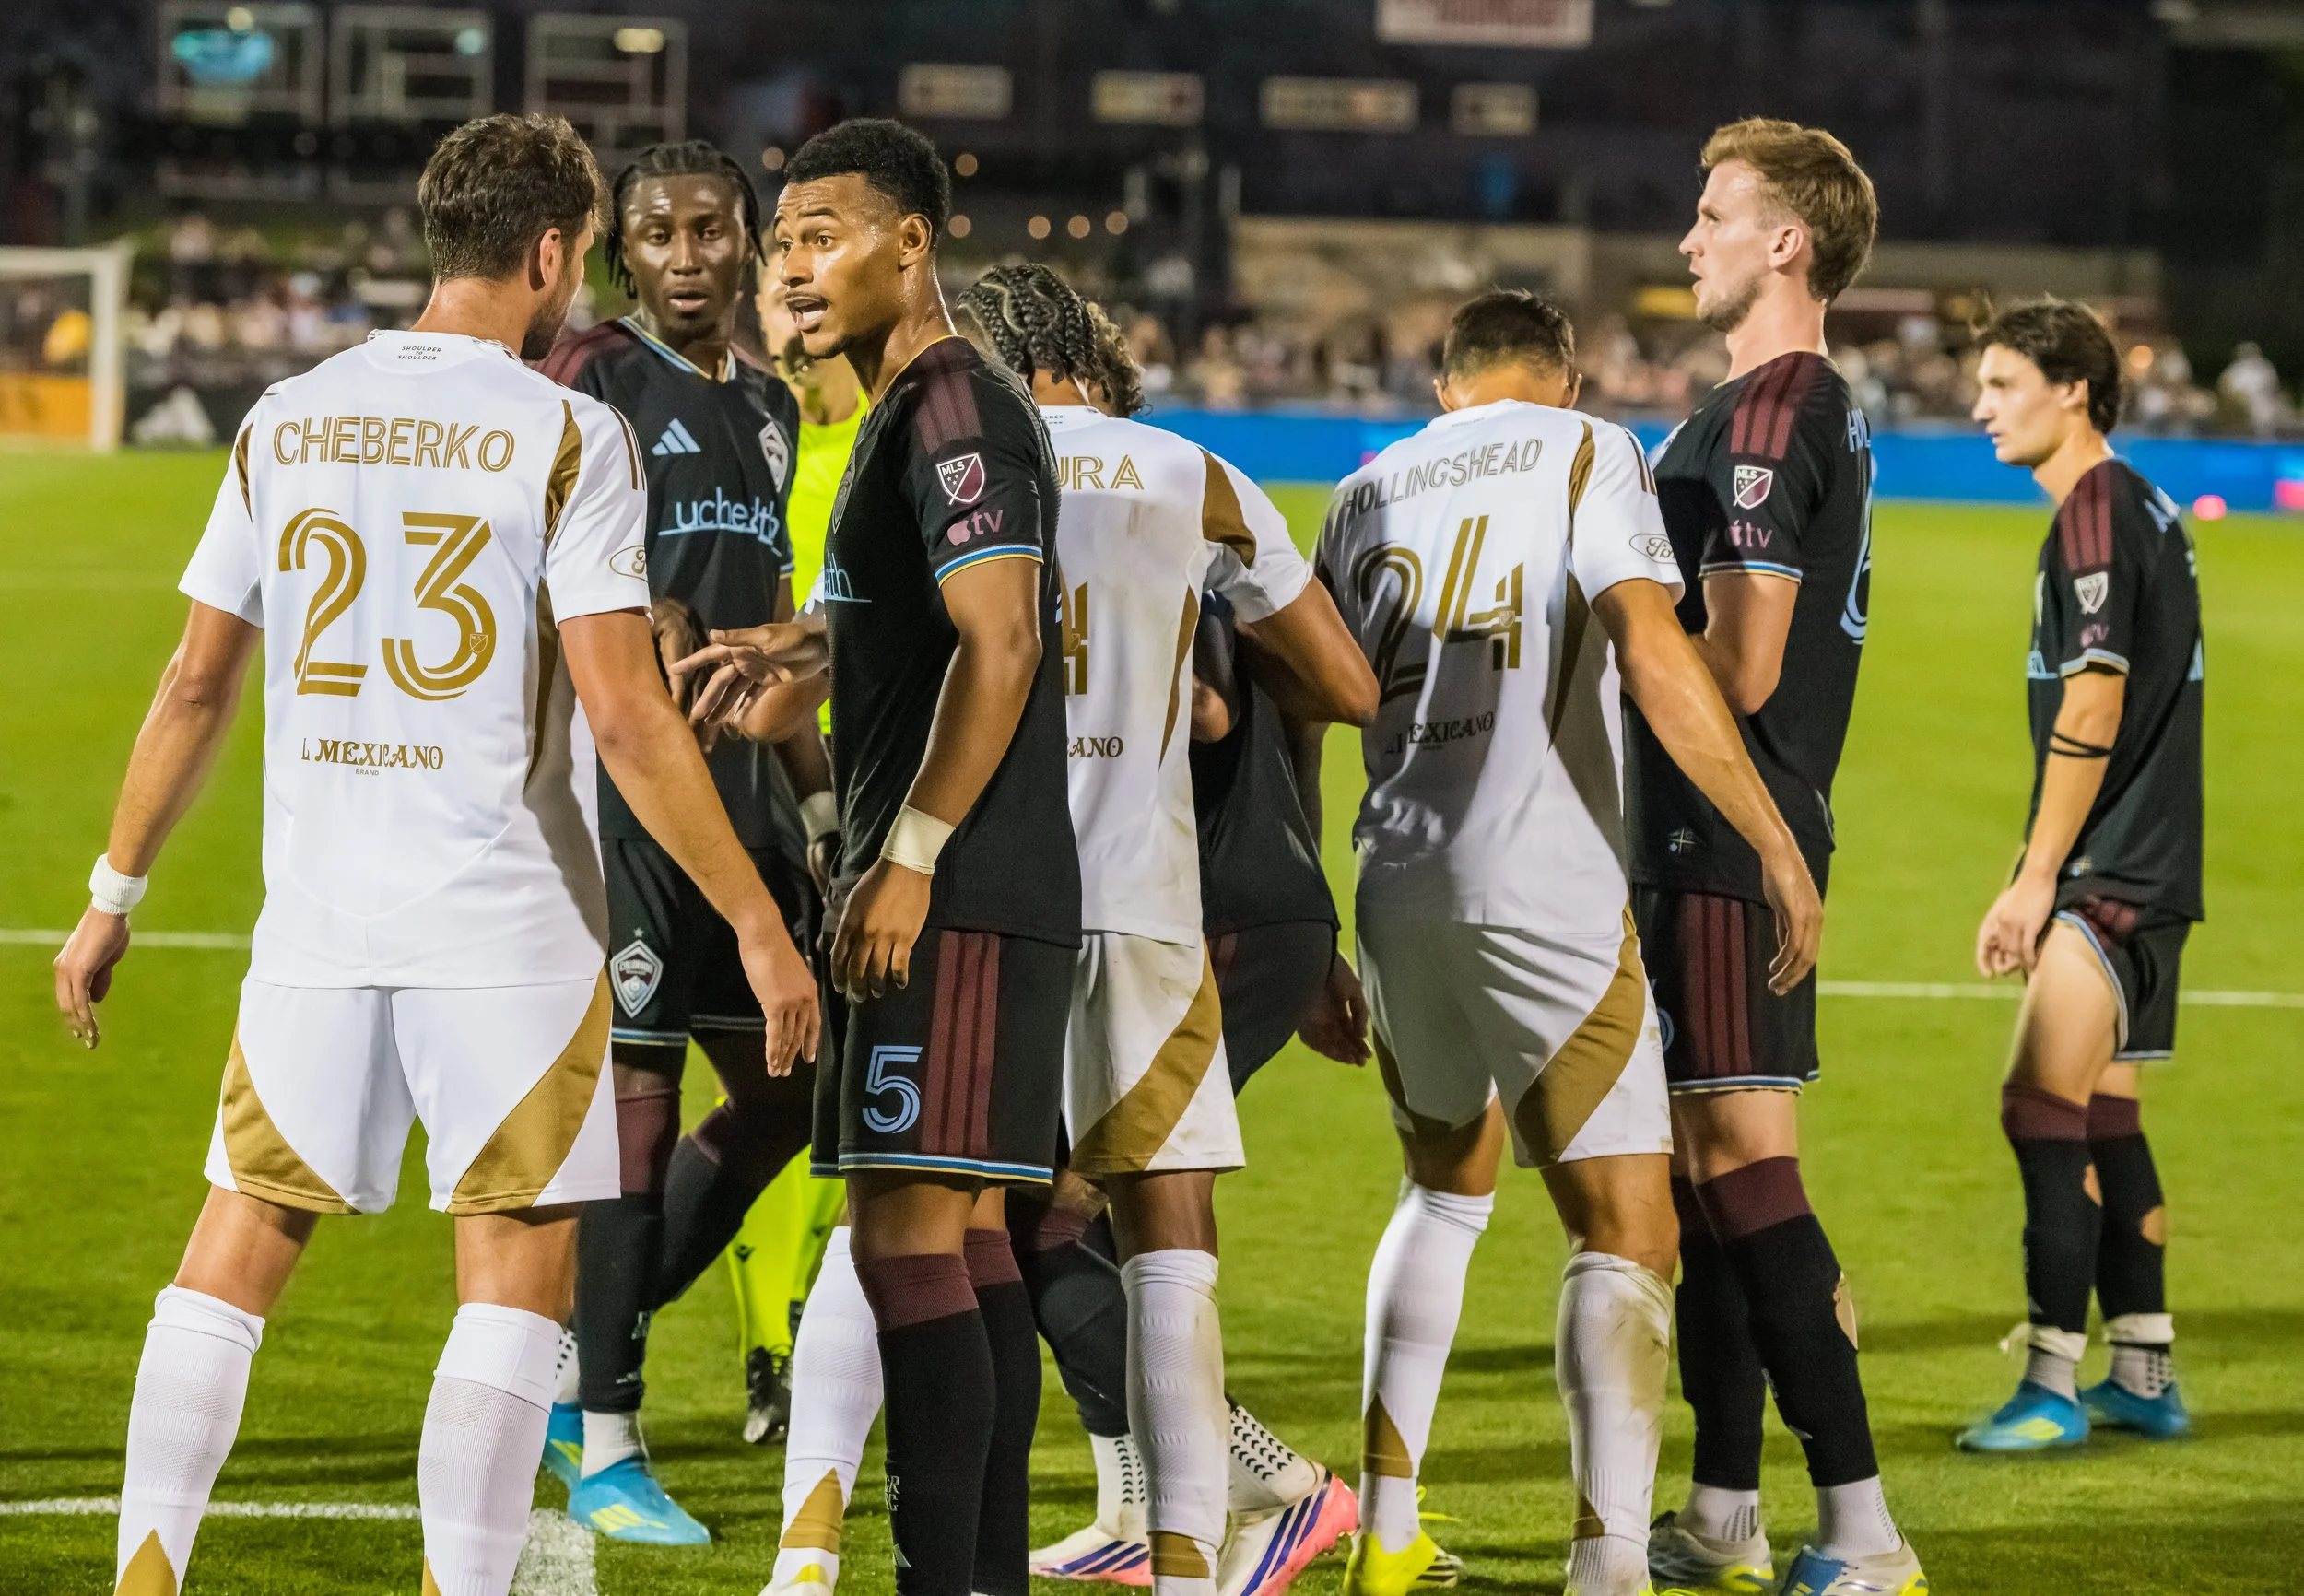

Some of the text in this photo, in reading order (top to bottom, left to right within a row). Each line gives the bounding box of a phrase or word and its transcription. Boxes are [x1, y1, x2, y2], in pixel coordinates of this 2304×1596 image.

[273, 416, 515, 473] CHEBERKO
[941, 461, 965, 476] MLS
[1340, 438, 1543, 521] HOLLINGSHEAD
[1737, 469, 1757, 480] MLS
[971, 510, 1004, 535] tv
[278, 508, 497, 701] 23
[1353, 514, 1524, 707] 24
[314, 738, 444, 770] MEXICANO
[355, 769, 380, 777] BRAND
[862, 1045, 923, 1134] 5
